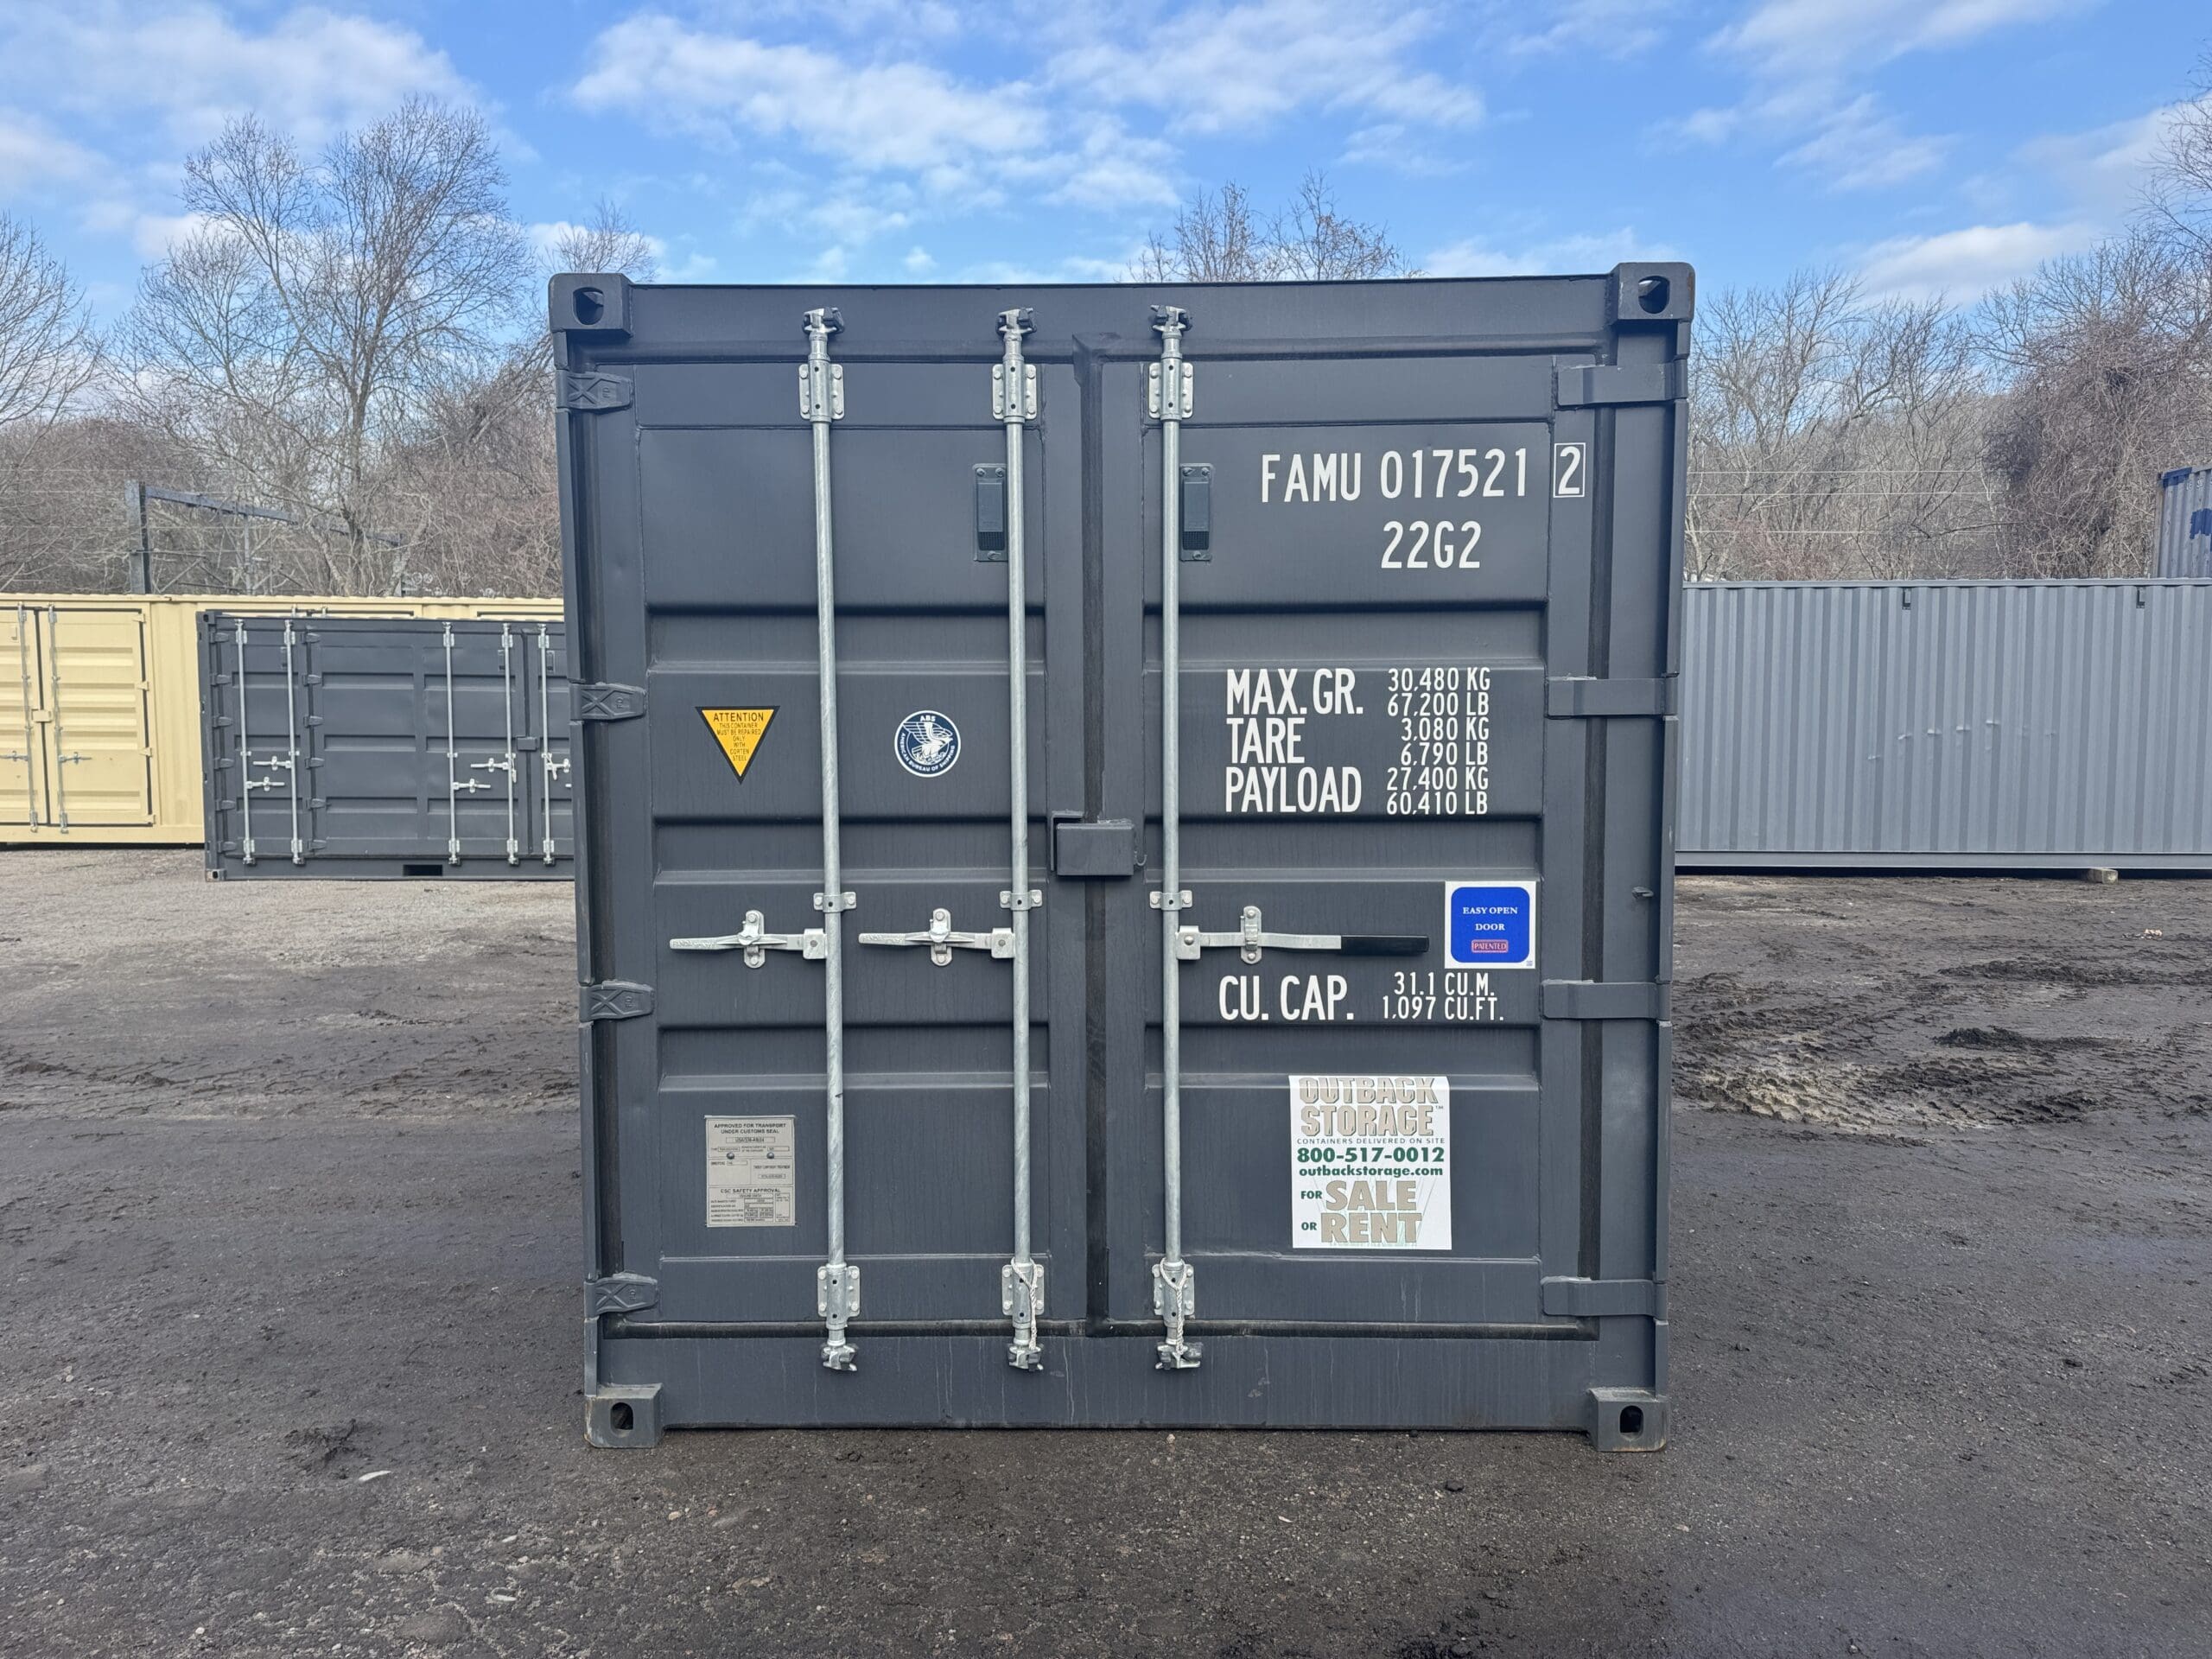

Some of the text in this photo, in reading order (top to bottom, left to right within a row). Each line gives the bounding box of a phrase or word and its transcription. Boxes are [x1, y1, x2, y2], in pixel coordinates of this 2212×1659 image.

[1262, 447, 1581, 503] FAMU 017521 2
[1381, 520, 1482, 569] 22G2
[1388, 668, 1491, 692] 30,480 KG
[714, 713, 764, 721] ATTENTION
[1388, 692, 1489, 718] 67,200 LB
[1227, 717, 1305, 764] TARE
[1401, 718, 1489, 742] 3,080 KG
[899, 733, 910, 762] AMERICAN
[908, 760, 931, 772] BUREAU
[1401, 742, 1488, 766] 6,790 LB
[1226, 766, 1362, 813] PAYLOAD
[1387, 767, 1489, 791] 27,400 KG
[1387, 791, 1488, 816] 60,410 LB
[1394, 972, 1495, 996] 31.1 CU.M.
[1218, 975, 1354, 1020] CU. CAP.
[1382, 995, 1504, 1021] 1,097 CU.FT.
[1299, 1077, 1439, 1104] OUTBACK
[1300, 1105, 1434, 1136] STORAGE
[1297, 1147, 1445, 1163] 800-517-0012
[1299, 1165, 1443, 1178] outbackstorage.com
[1300, 1180, 1417, 1211] FOR SALE
[1301, 1212, 1422, 1243] OR RENT
